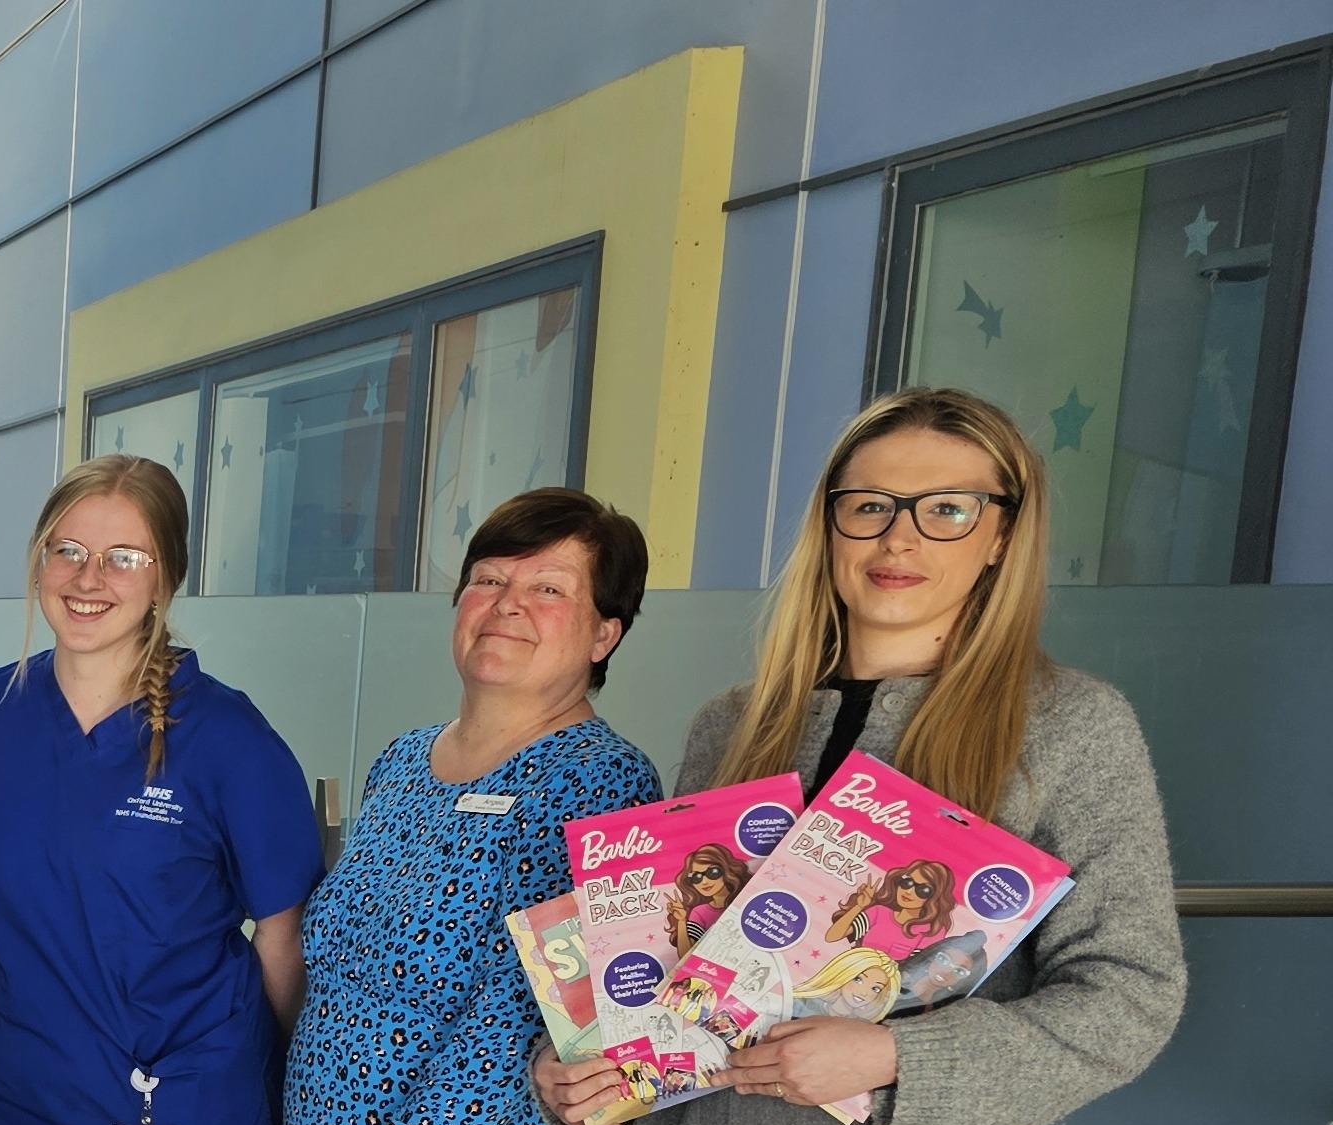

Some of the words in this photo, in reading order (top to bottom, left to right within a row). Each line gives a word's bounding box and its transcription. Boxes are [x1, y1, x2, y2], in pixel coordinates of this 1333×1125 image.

[143, 786, 173, 801] NHS
[829, 773, 913, 835] Barbie
[115, 809, 130, 817] NHS
[580, 825, 663, 871] Barbie
[807, 812, 880, 859] PLAY
[790, 832, 865, 883] PACK
[585, 869, 653, 902] PLAY
[589, 891, 660, 925] PACK
[765, 898, 799, 922] Featuring
[744, 918, 762, 931] their
[760, 927, 786, 945] friends
[748, 910, 779, 930] Brooklyn
[778, 928, 794, 938] and
[614, 962, 650, 973] Featuring
[611, 980, 643, 991] Brooklyn
[644, 976, 658, 985] and
[633, 985, 657, 995] friend
